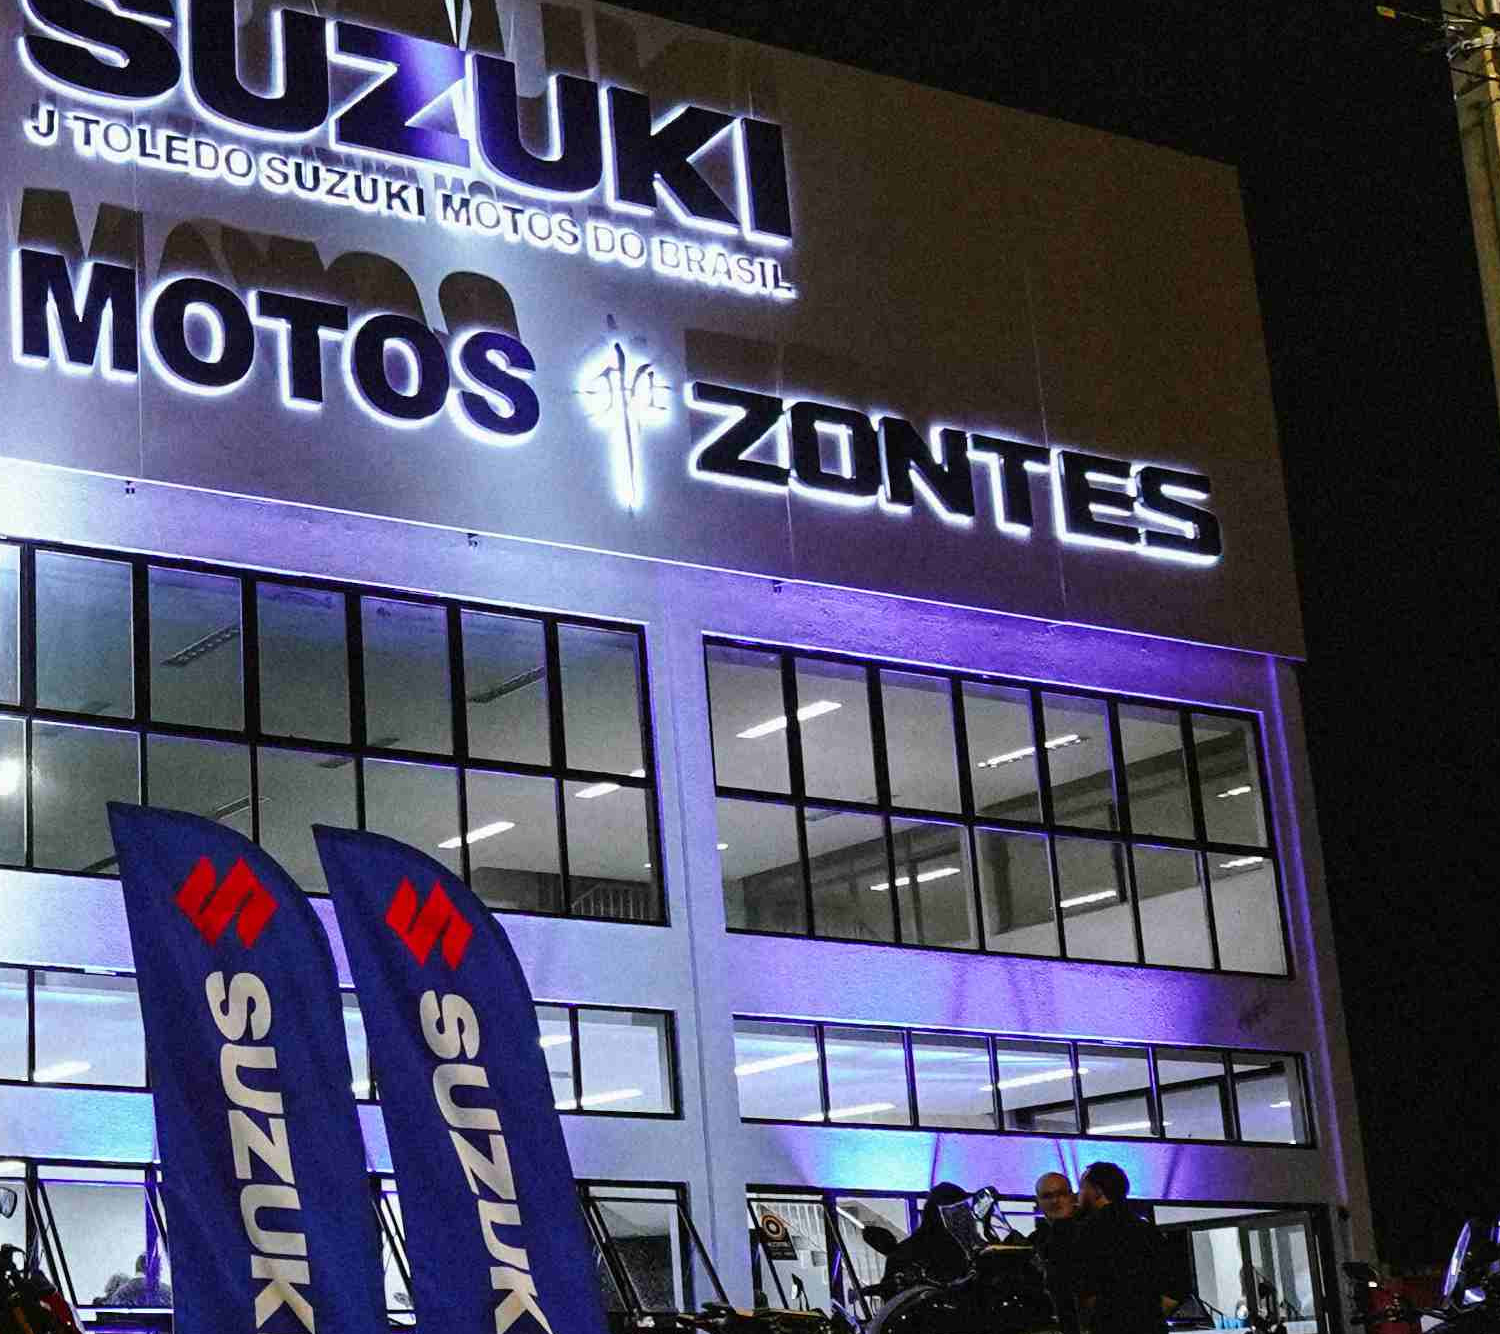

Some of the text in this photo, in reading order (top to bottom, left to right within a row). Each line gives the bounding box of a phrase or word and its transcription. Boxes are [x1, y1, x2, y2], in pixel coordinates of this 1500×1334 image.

[73, 115, 253, 178] TOLEDO
[265, 156, 425, 217] SUZUKI
[442, 193, 579, 246] MOTOS
[593, 224, 645, 260] DO
[659, 239, 793, 293] BRASIL
[20, 248, 541, 437] MOTOS
[692, 381, 1222, 558] ZONTES
